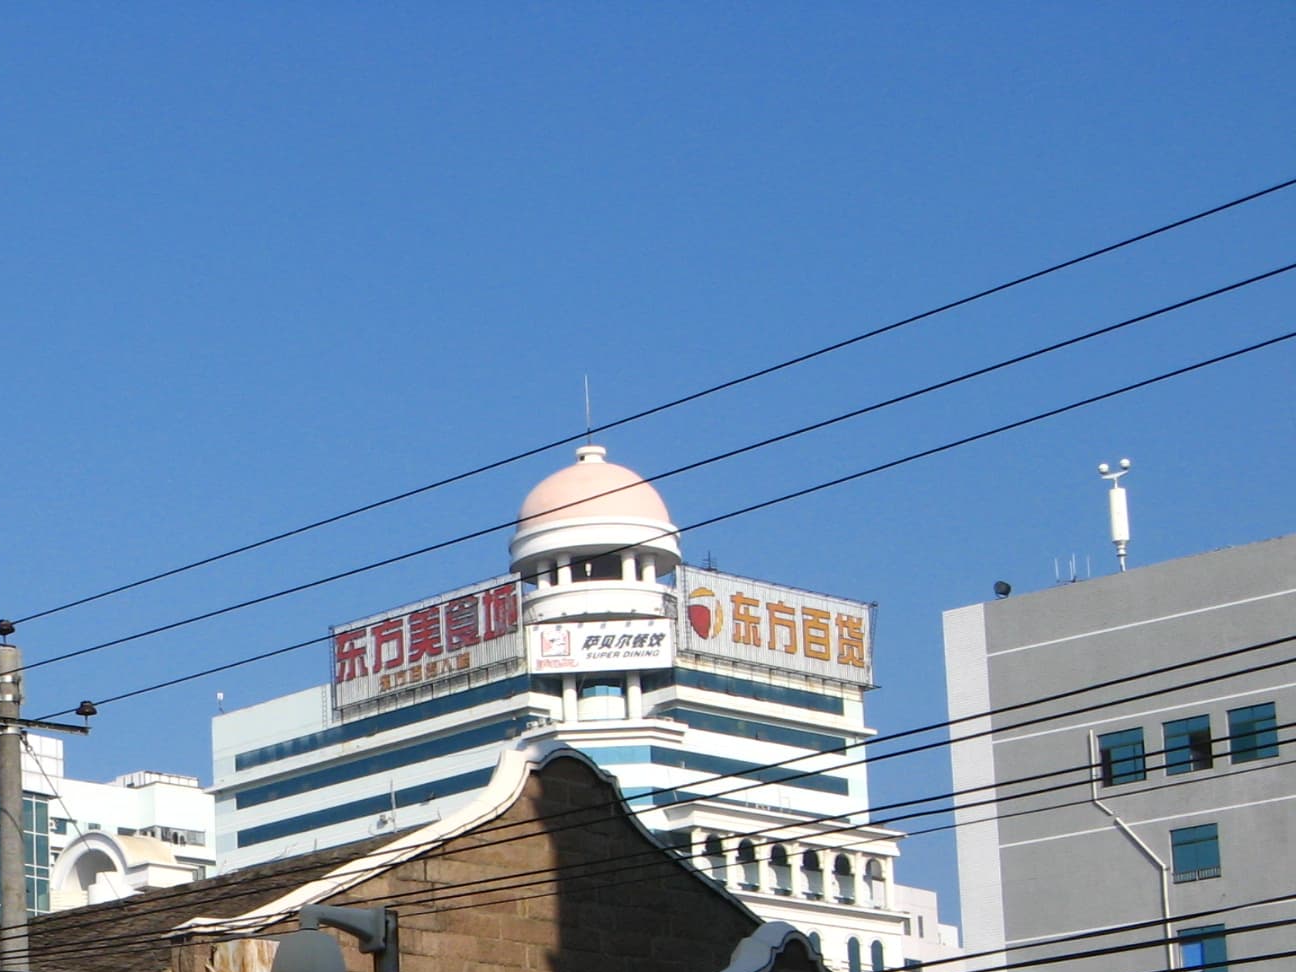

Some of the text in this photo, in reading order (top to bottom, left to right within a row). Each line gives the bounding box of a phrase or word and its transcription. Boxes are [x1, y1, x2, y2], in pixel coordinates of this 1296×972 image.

[335, 583, 518, 684] 东方美食城
[582, 632, 666, 650] 萨贝尔餐饮
[730, 591, 866, 668] 东方百货
[586, 649, 661, 659] SUPER DINING
